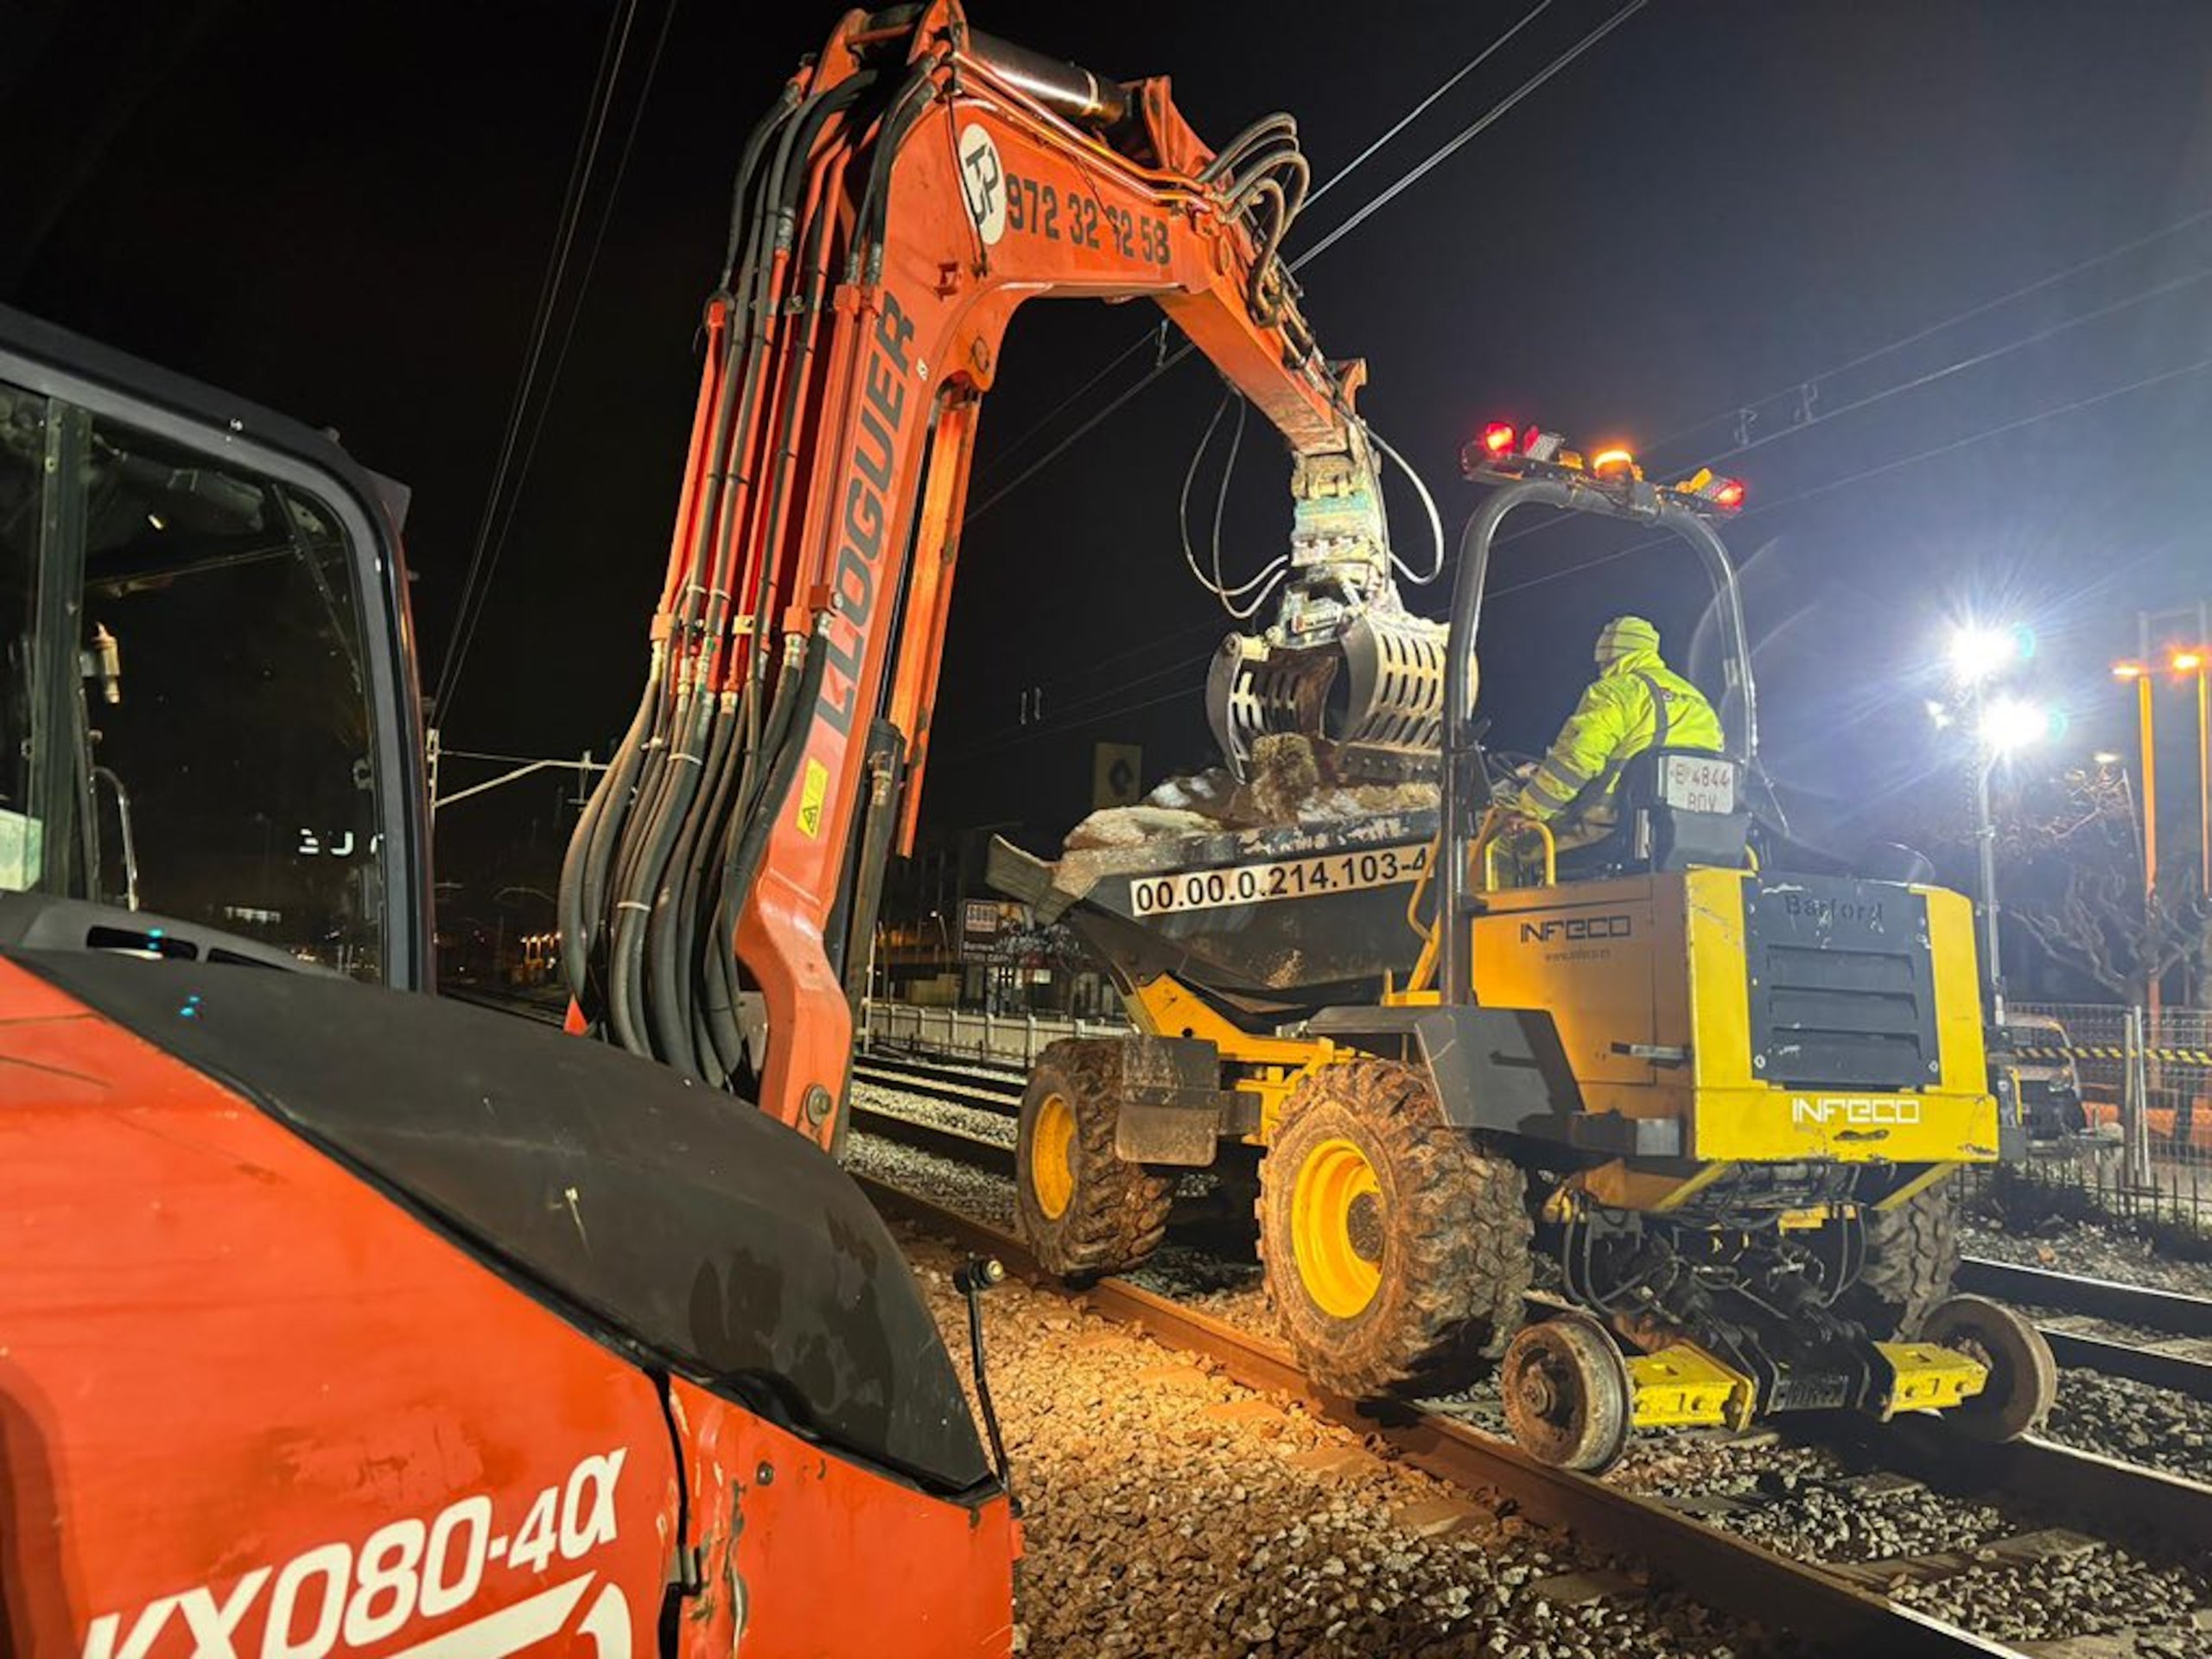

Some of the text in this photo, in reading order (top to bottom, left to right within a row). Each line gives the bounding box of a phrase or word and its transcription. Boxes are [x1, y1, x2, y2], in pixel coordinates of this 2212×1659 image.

[1006, 173, 1060, 240] 972
[1068, 193, 1101, 250] 32
[1141, 216, 1172, 265] 58
[815, 290, 914, 739] LLOGUER
